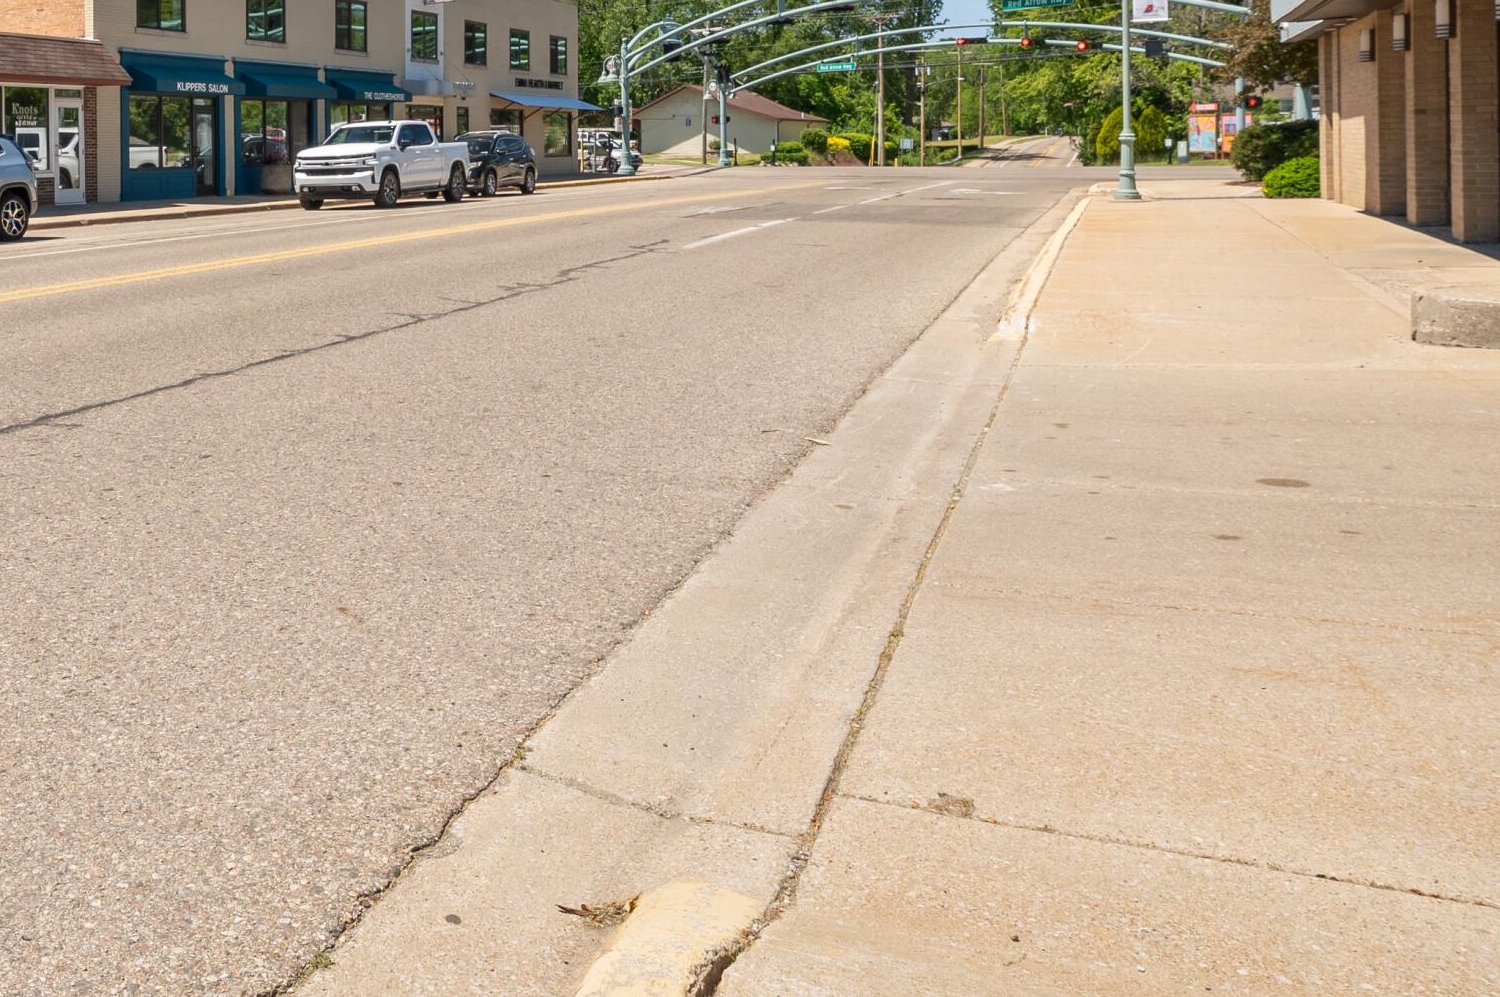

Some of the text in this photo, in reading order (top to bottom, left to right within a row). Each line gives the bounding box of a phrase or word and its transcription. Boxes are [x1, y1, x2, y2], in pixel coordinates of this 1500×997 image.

[1008, 0, 1022, 8] Red
[177, 82, 229, 93] KLIPPERS SALON
[364, 91, 373, 100] THE
[12, 102, 38, 115] Knots
